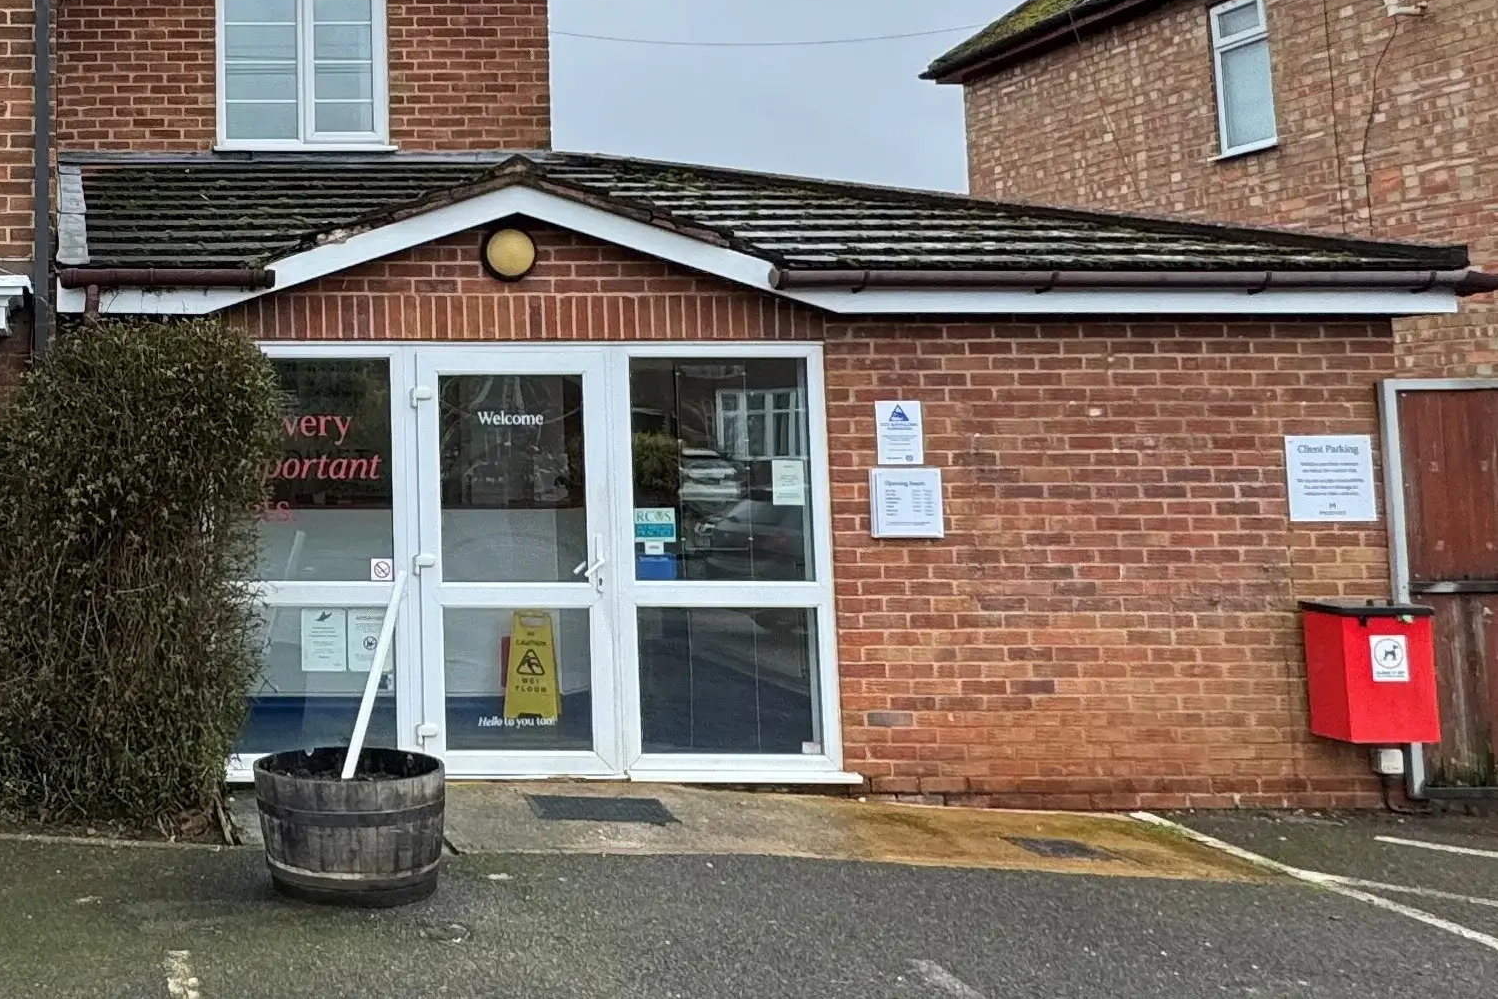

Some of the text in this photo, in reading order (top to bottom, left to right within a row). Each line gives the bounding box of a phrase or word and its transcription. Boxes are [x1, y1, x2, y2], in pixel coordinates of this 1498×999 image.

[477, 409, 544, 425] Welcome
[280, 414, 352, 446] very
[1297, 445, 1359, 456] Client Parking
[257, 454, 382, 487] portant
[515, 685, 547, 693] FLOOR
[478, 716, 503, 726] Hello
[504, 717, 514, 726] to
[516, 718, 535, 728] you
